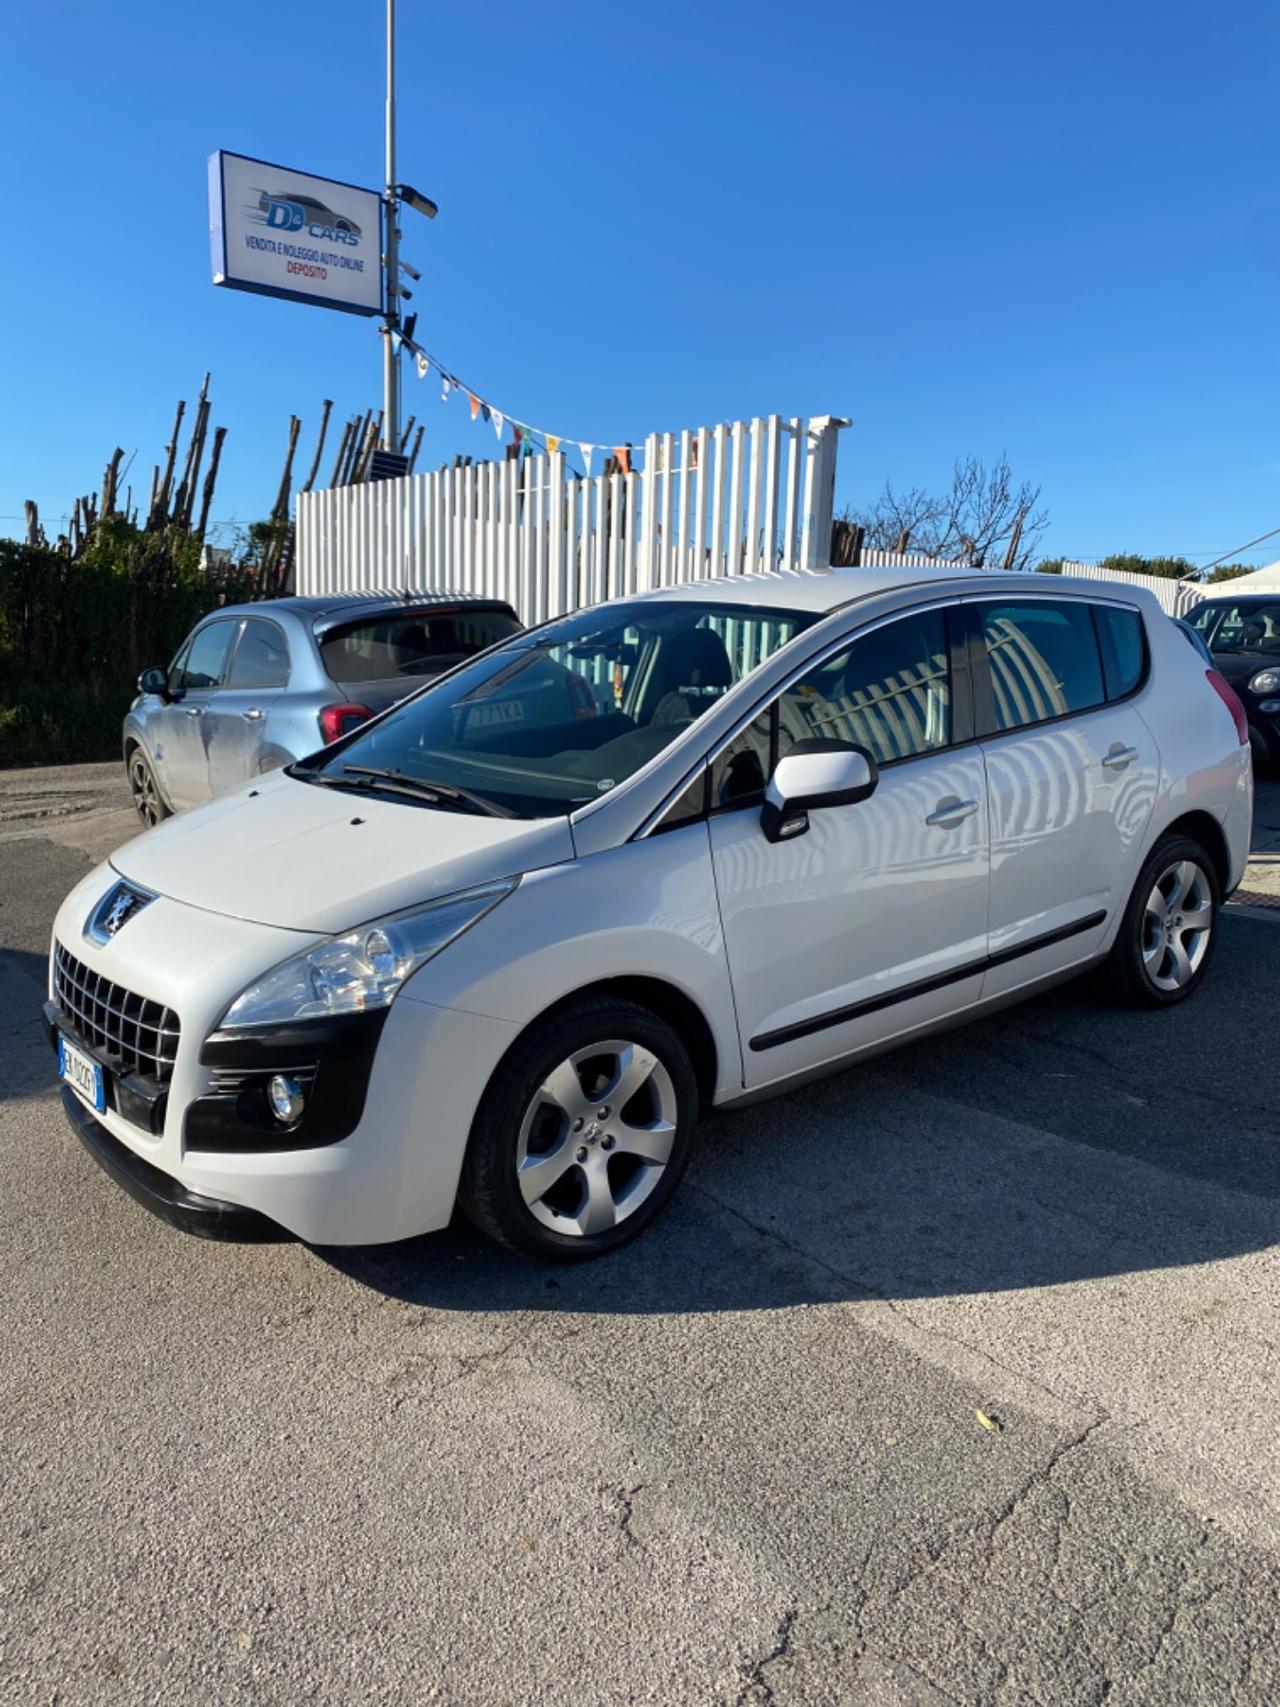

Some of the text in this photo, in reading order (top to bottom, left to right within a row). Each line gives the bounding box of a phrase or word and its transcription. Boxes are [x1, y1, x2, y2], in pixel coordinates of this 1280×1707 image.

[308, 223, 359, 247] CARS
[245, 235, 365, 273] VENDITA E NOLEGGIO AUTO ONLINE
[287, 260, 328, 280] DEPOSITO
